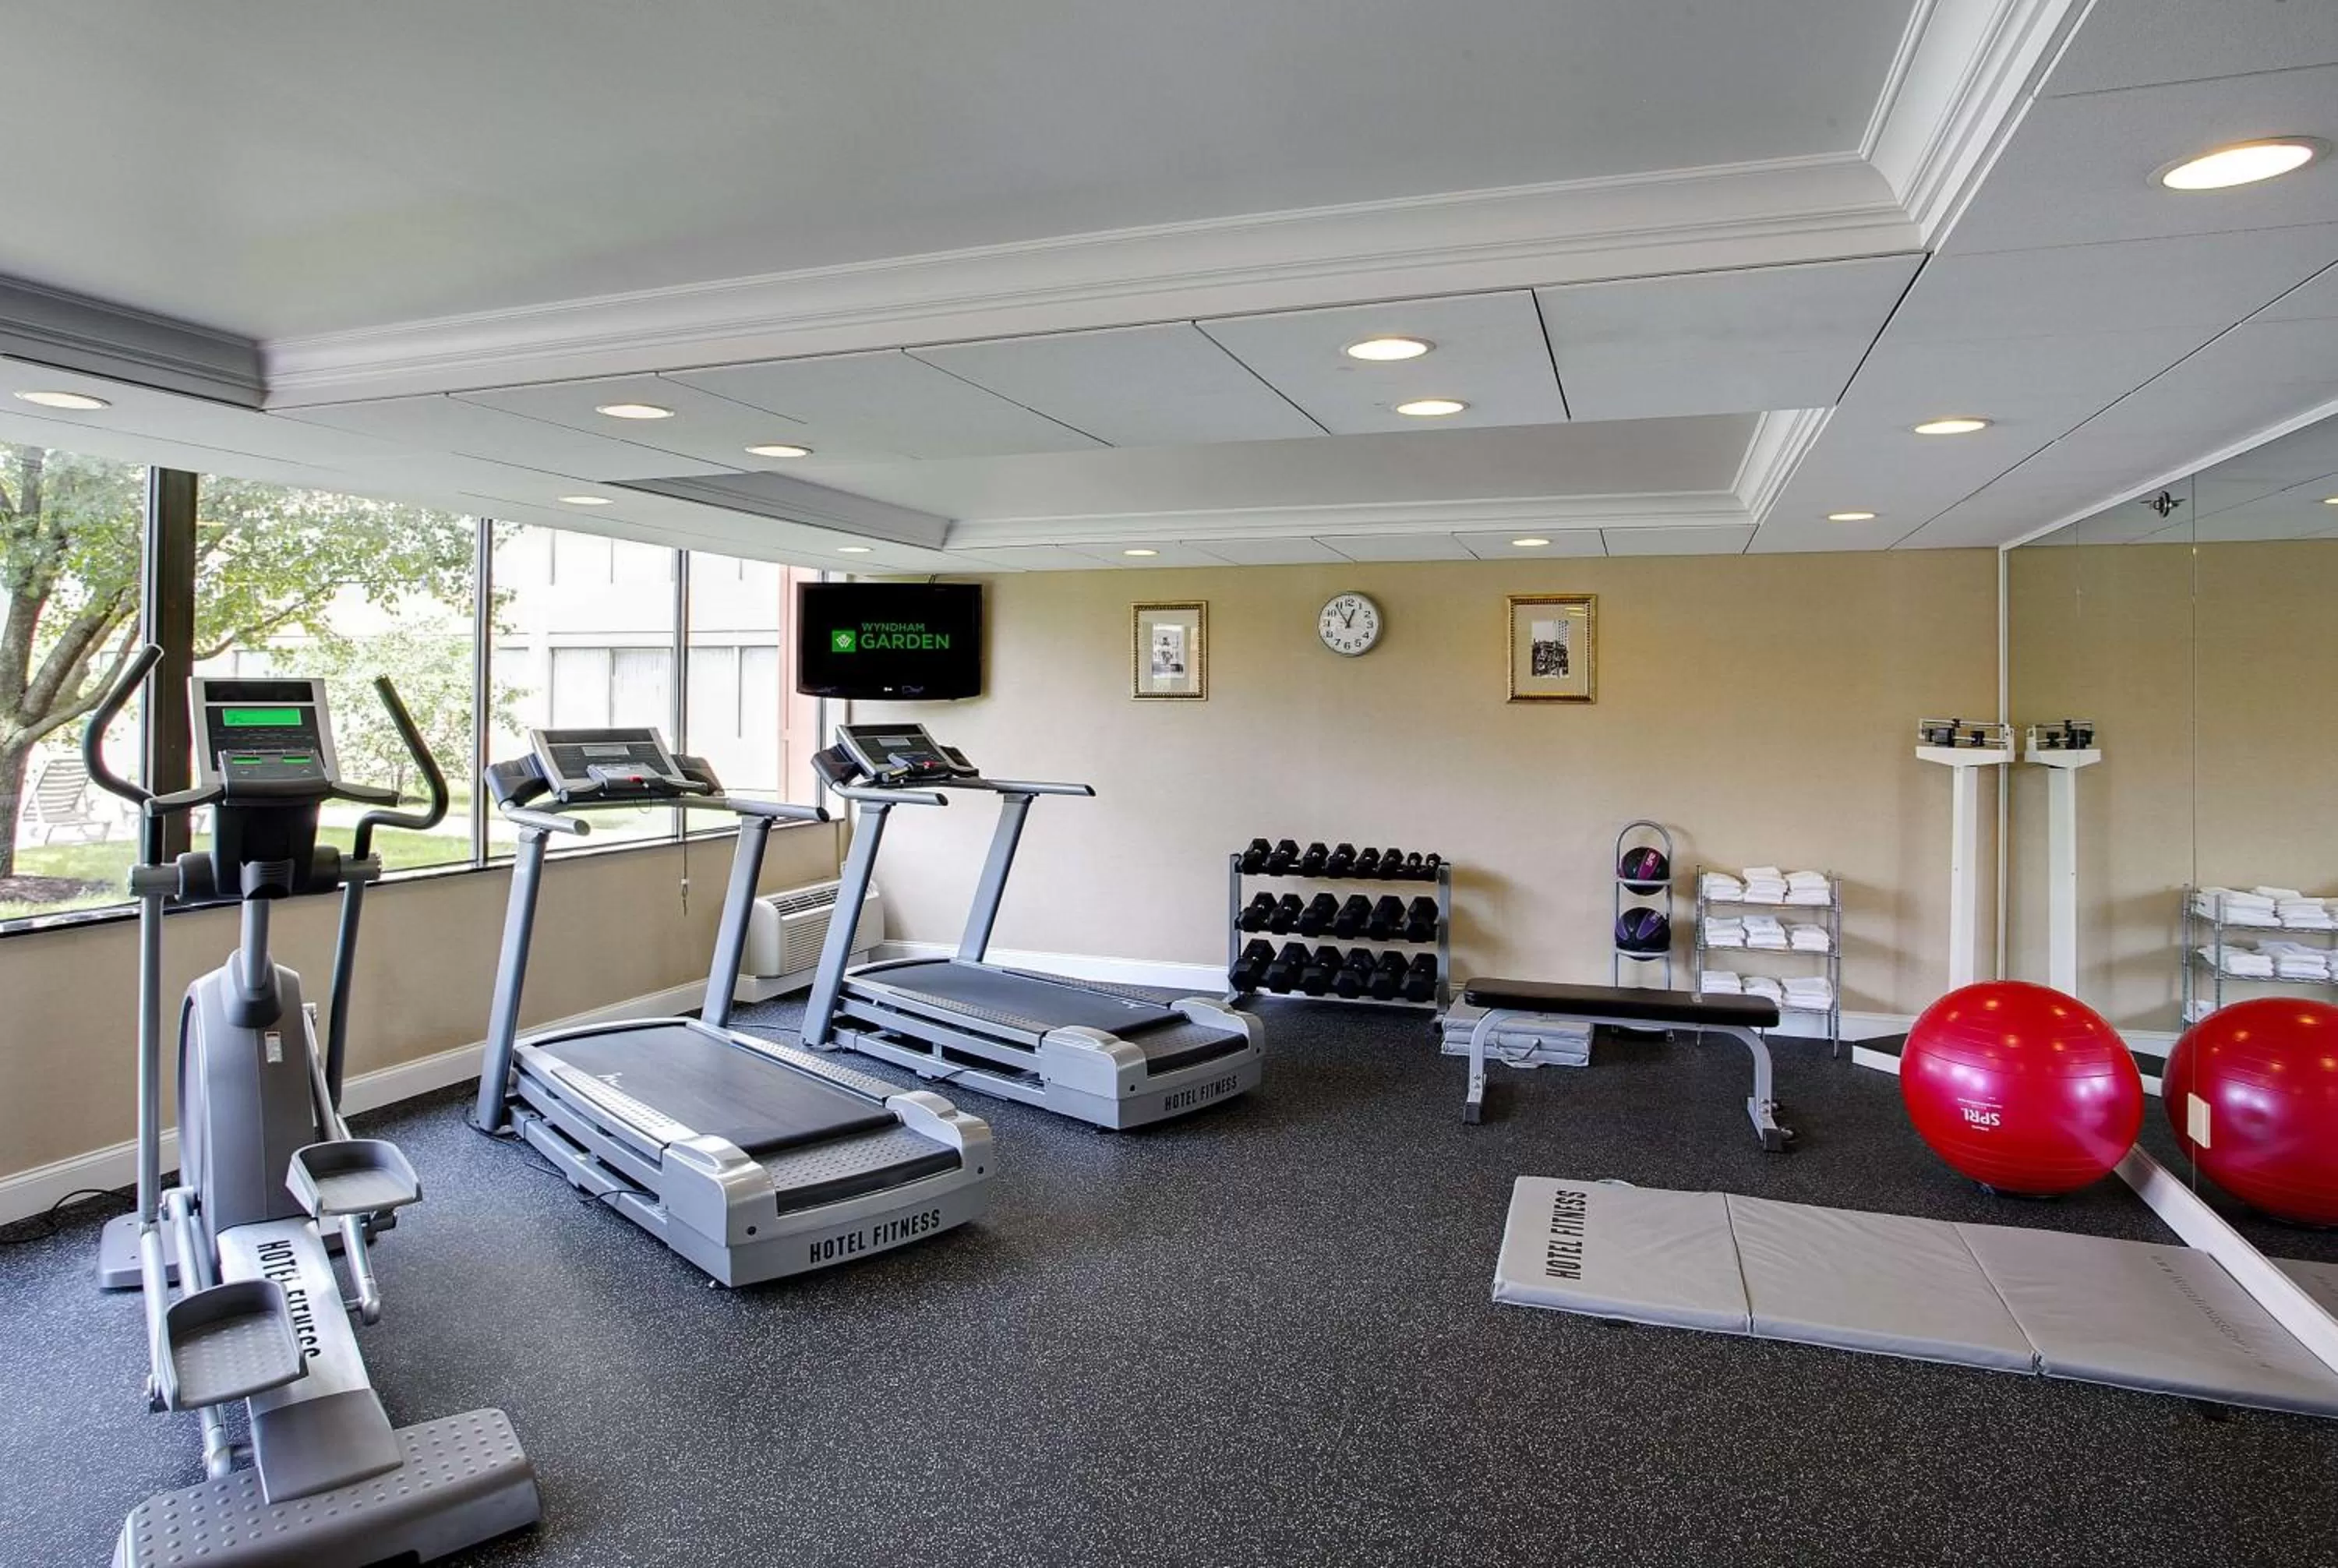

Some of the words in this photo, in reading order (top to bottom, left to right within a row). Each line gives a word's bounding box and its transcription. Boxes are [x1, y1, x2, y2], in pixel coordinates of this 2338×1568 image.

[1345, 599, 1354, 607] 12
[860, 623, 926, 632] WYNDHAM
[1366, 620, 1374, 629] 3
[860, 633, 950, 649] GARDEN
[1344, 641, 1351, 650] 6
[1164, 1089, 1196, 1111] HOTEL
[1200, 1075, 1238, 1100] FITNESS
[1550, 1190, 1588, 1237] FITNESS
[810, 1231, 867, 1263] HOTEL
[873, 1209, 941, 1246] FITNESS
[1546, 1240, 1583, 1280] HOTEL
